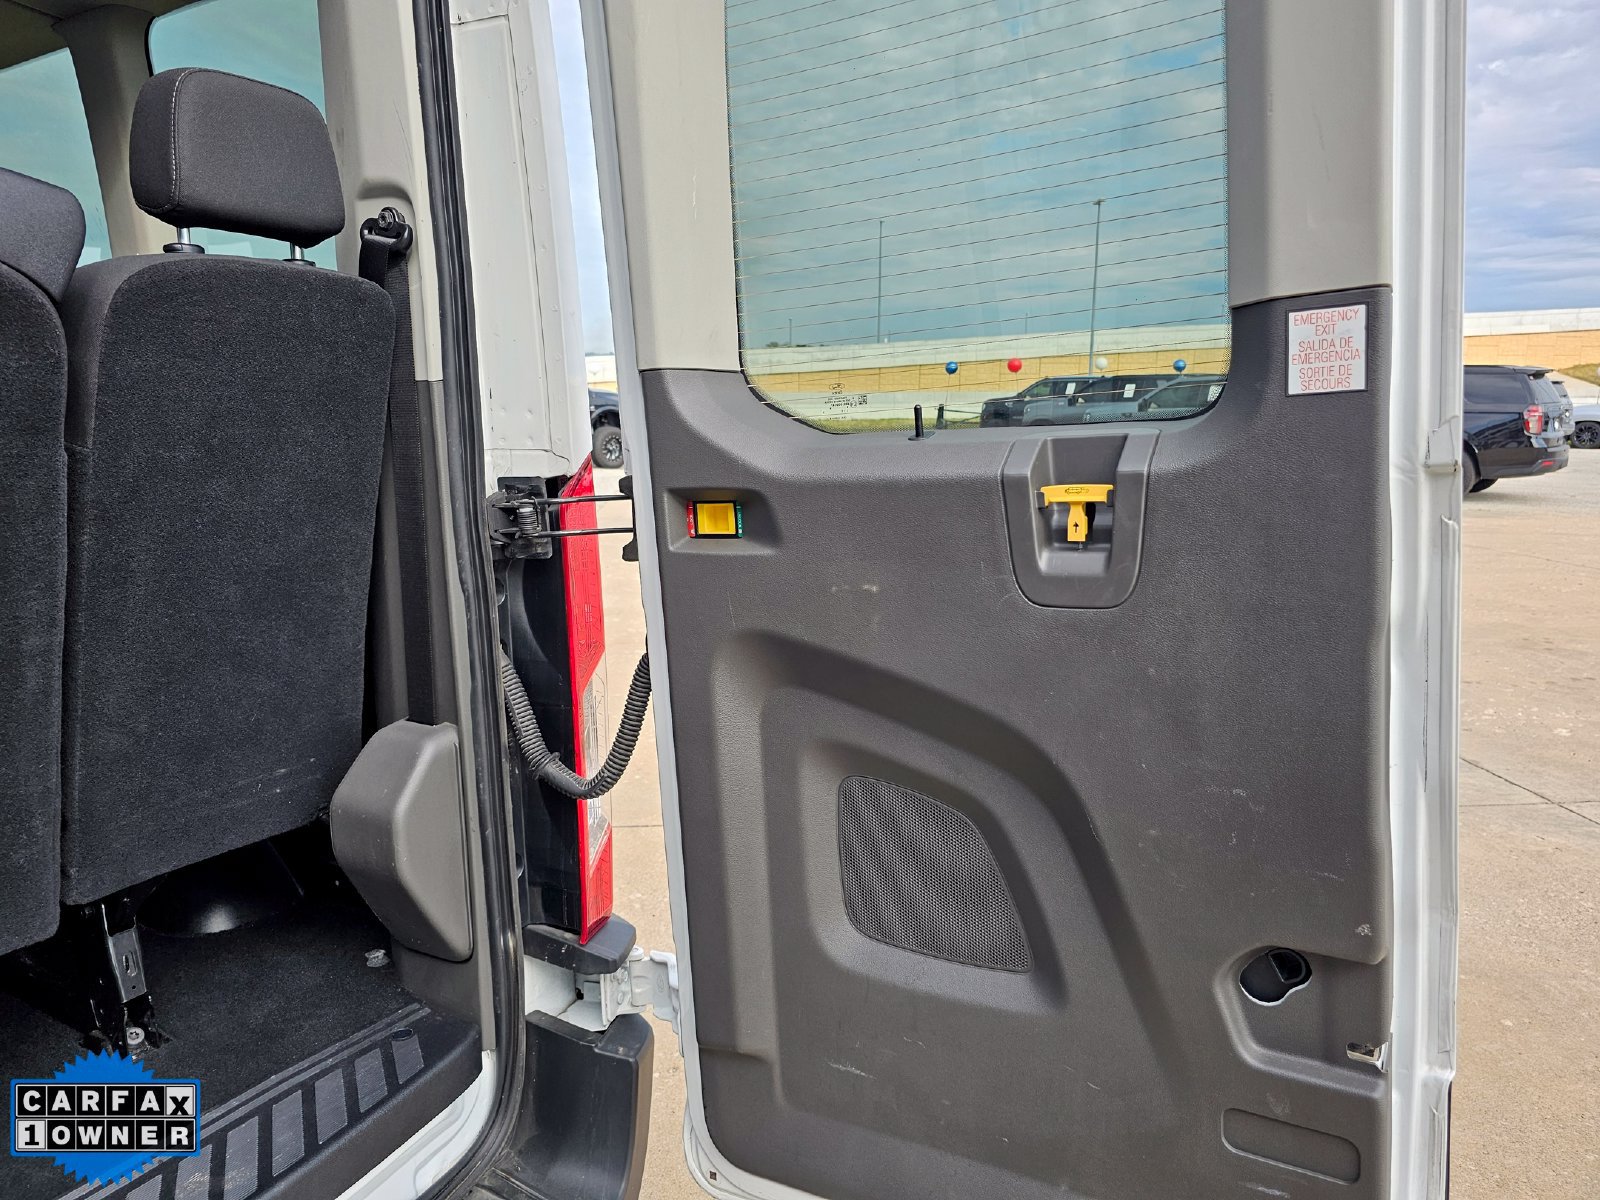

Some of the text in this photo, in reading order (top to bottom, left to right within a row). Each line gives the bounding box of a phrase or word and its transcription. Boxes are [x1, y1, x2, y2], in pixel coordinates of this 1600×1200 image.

[1293, 308, 1359, 326] EMERGENCY
[1315, 323, 1336, 336] EXIT
[1298, 336, 1353, 353] SALIDA DE
[1291, 348, 1360, 365] EMERGENCIA
[1299, 364, 1352, 380] SORTIE DE
[1300, 376, 1351, 392] SECOURS
